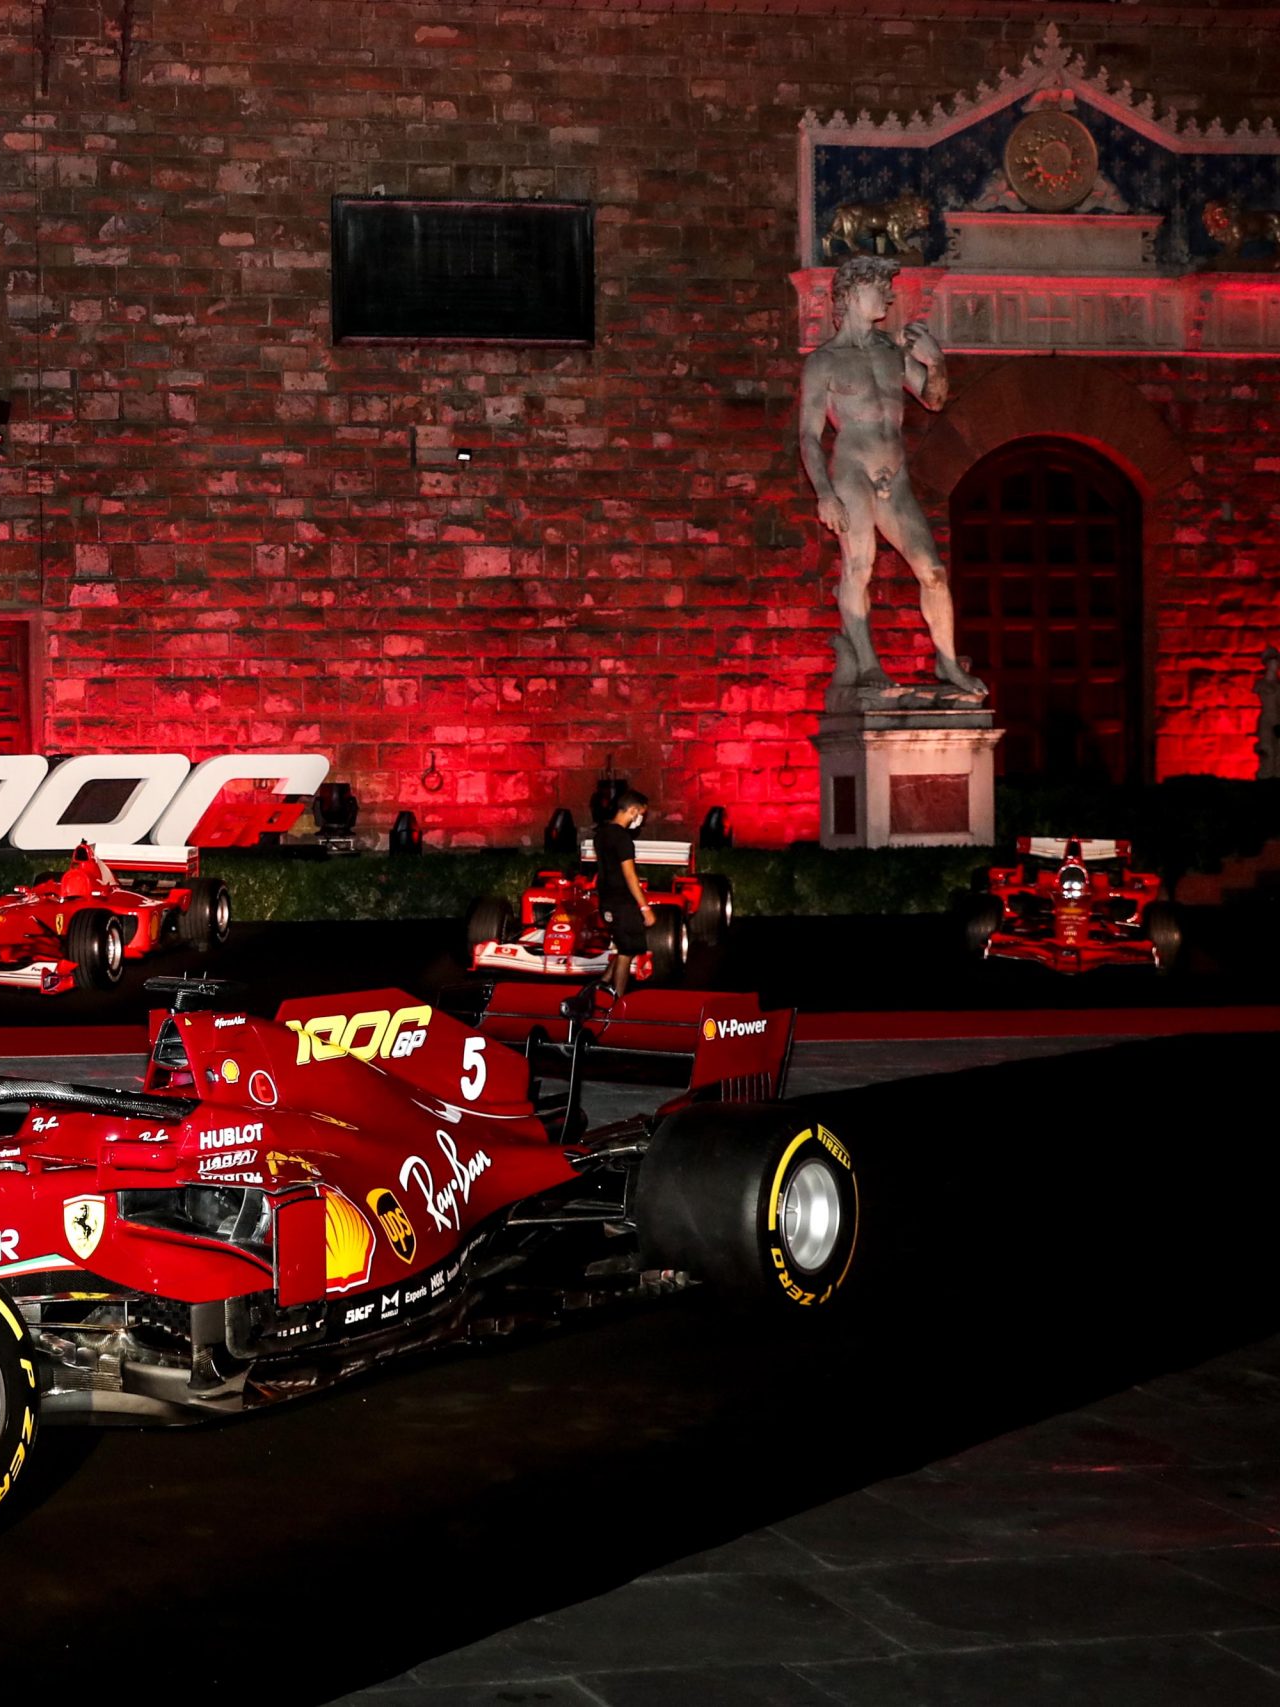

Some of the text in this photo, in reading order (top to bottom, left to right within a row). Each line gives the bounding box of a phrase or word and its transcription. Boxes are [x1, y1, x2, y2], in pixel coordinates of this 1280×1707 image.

[717, 1018, 767, 1039] V-Power
[460, 1037, 487, 1101] 5
[199, 1122, 264, 1150] HUBLOT
[817, 1123, 851, 1170] PIRELLI
[430, 1269, 445, 1292] NGK
[770, 1247, 816, 1306] ZERO
[345, 1303, 375, 1325] SKF
[20, 1358, 36, 1389] P
